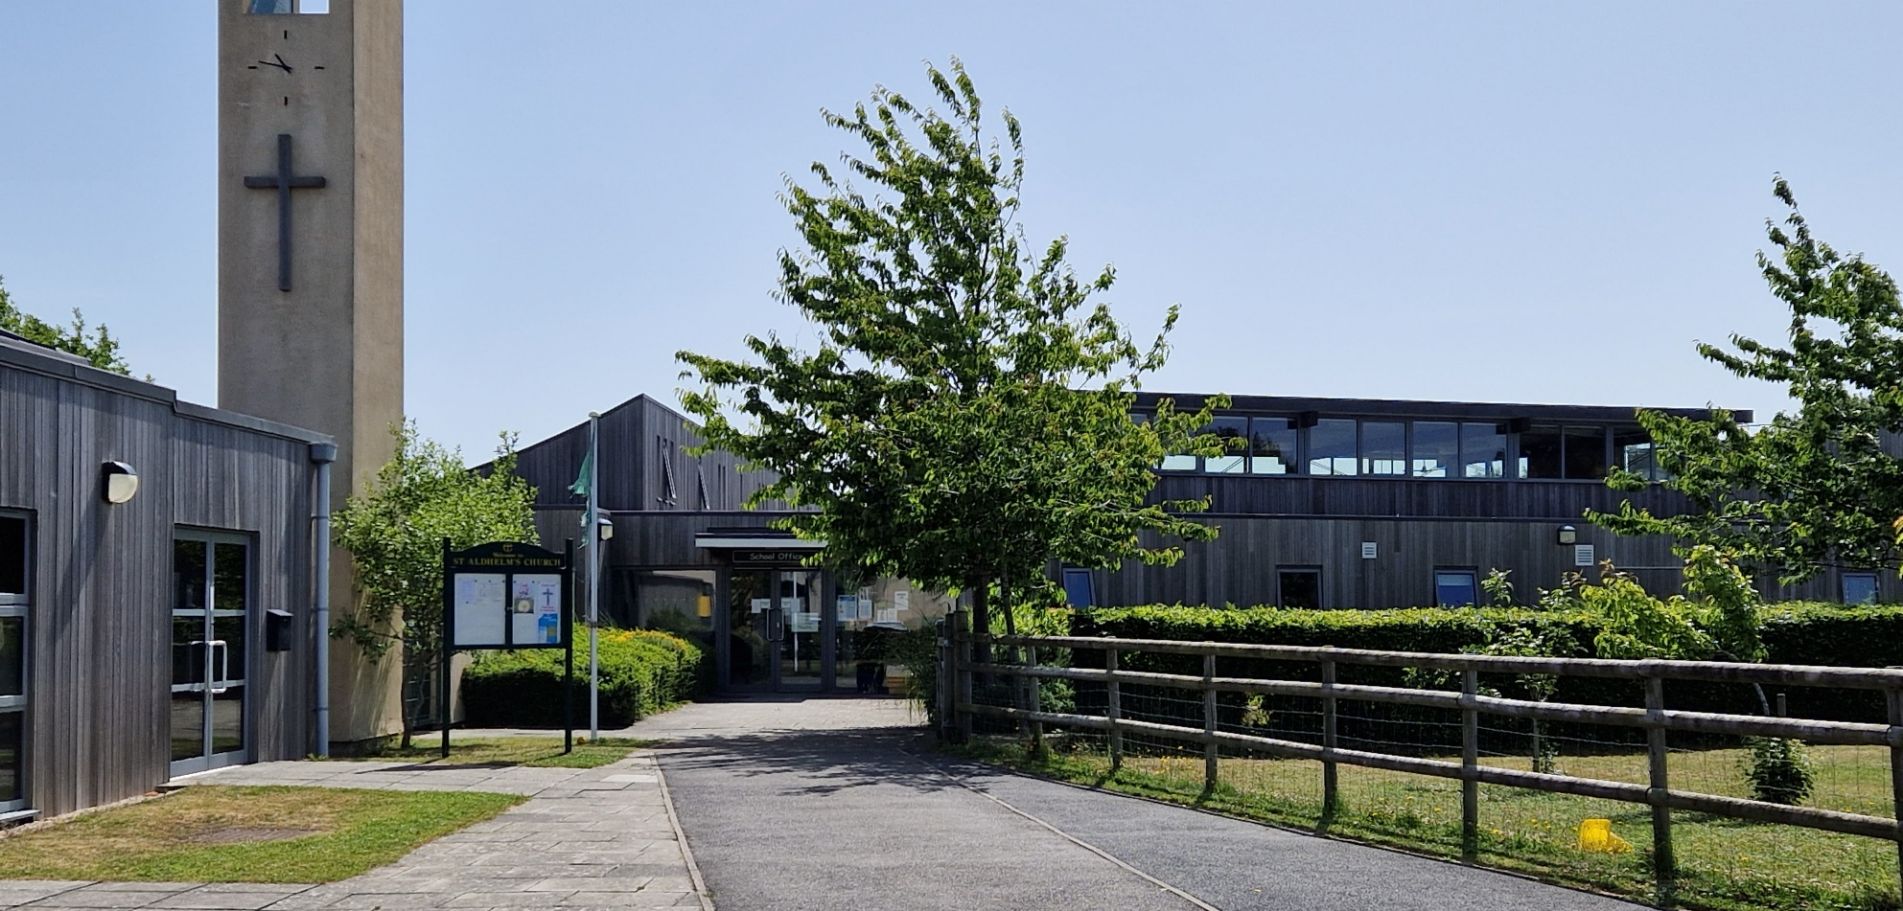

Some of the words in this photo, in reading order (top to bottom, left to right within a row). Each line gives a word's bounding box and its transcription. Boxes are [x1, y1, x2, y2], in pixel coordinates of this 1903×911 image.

[750, 552, 775, 560] School
[453, 558, 464, 566] ST
[470, 558, 521, 566] ALDHELM'S
[523, 558, 561, 566] CHURCH
